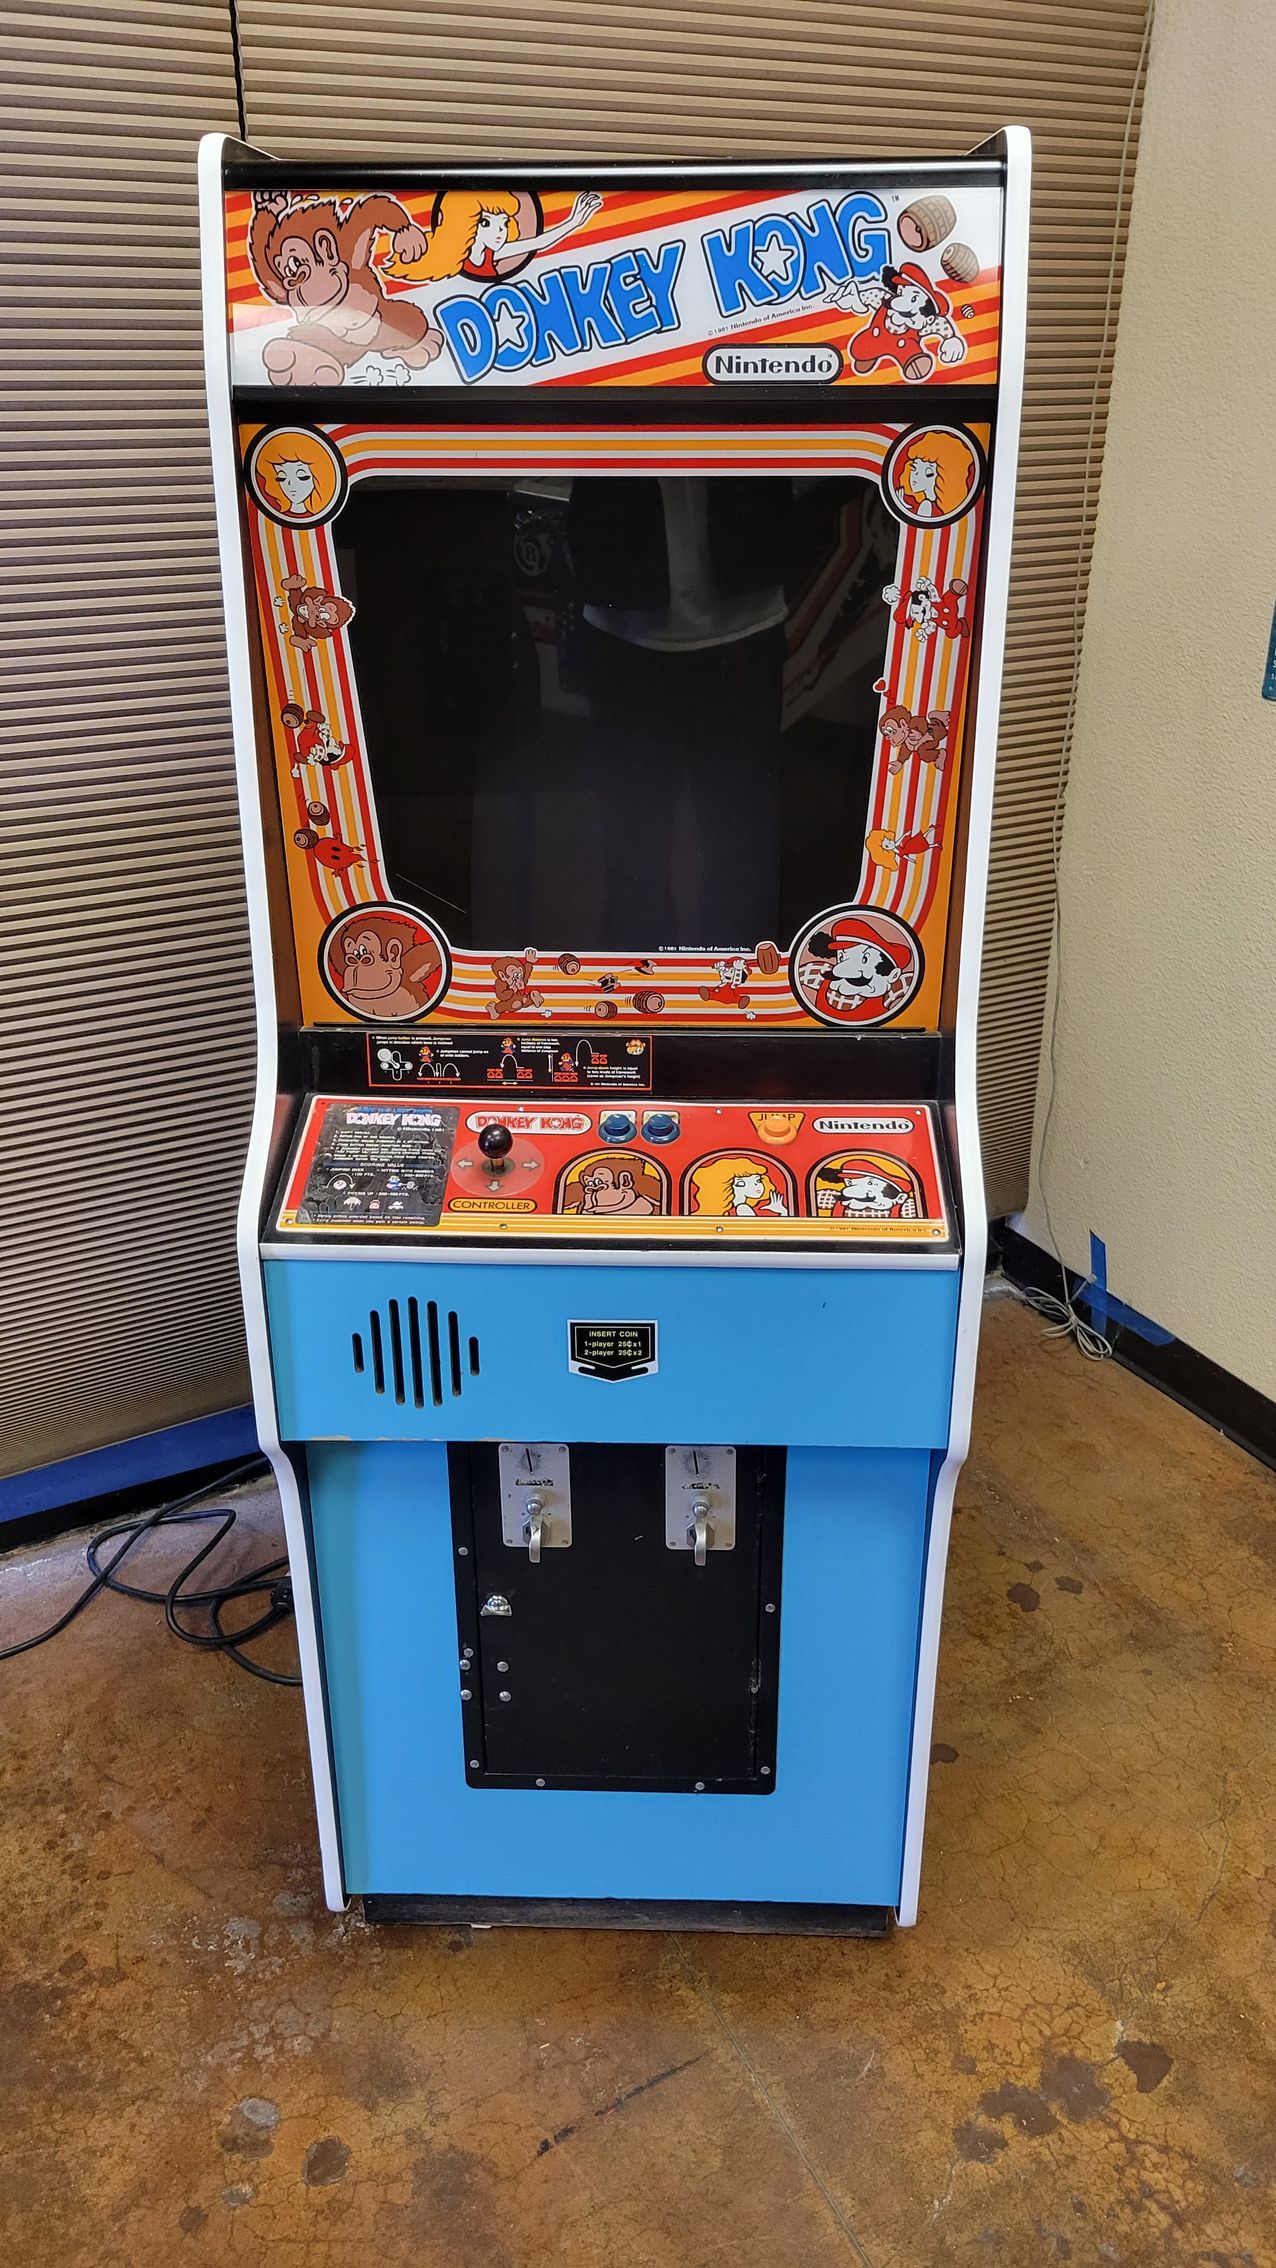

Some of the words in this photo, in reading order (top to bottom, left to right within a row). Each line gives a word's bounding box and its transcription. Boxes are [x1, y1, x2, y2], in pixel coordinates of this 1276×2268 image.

[434, 240, 685, 384] DONKEY
[701, 191, 892, 318] KONG
[730, 317, 762, 331] Nintendo
[771, 307, 801, 319] America
[802, 304, 815, 312] Inc.
[715, 355, 832, 374] Nintendo
[346, 1112, 401, 1125] DONKEY
[401, 1113, 442, 1126] KONG
[540, 1117, 584, 1129] KONG
[820, 1120, 909, 1130] Nintendo
[453, 1201, 530, 1210] CONTROLLER
[584, 1340, 614, 1348] 1-player
[584, 1349, 614, 1357] 2-player
